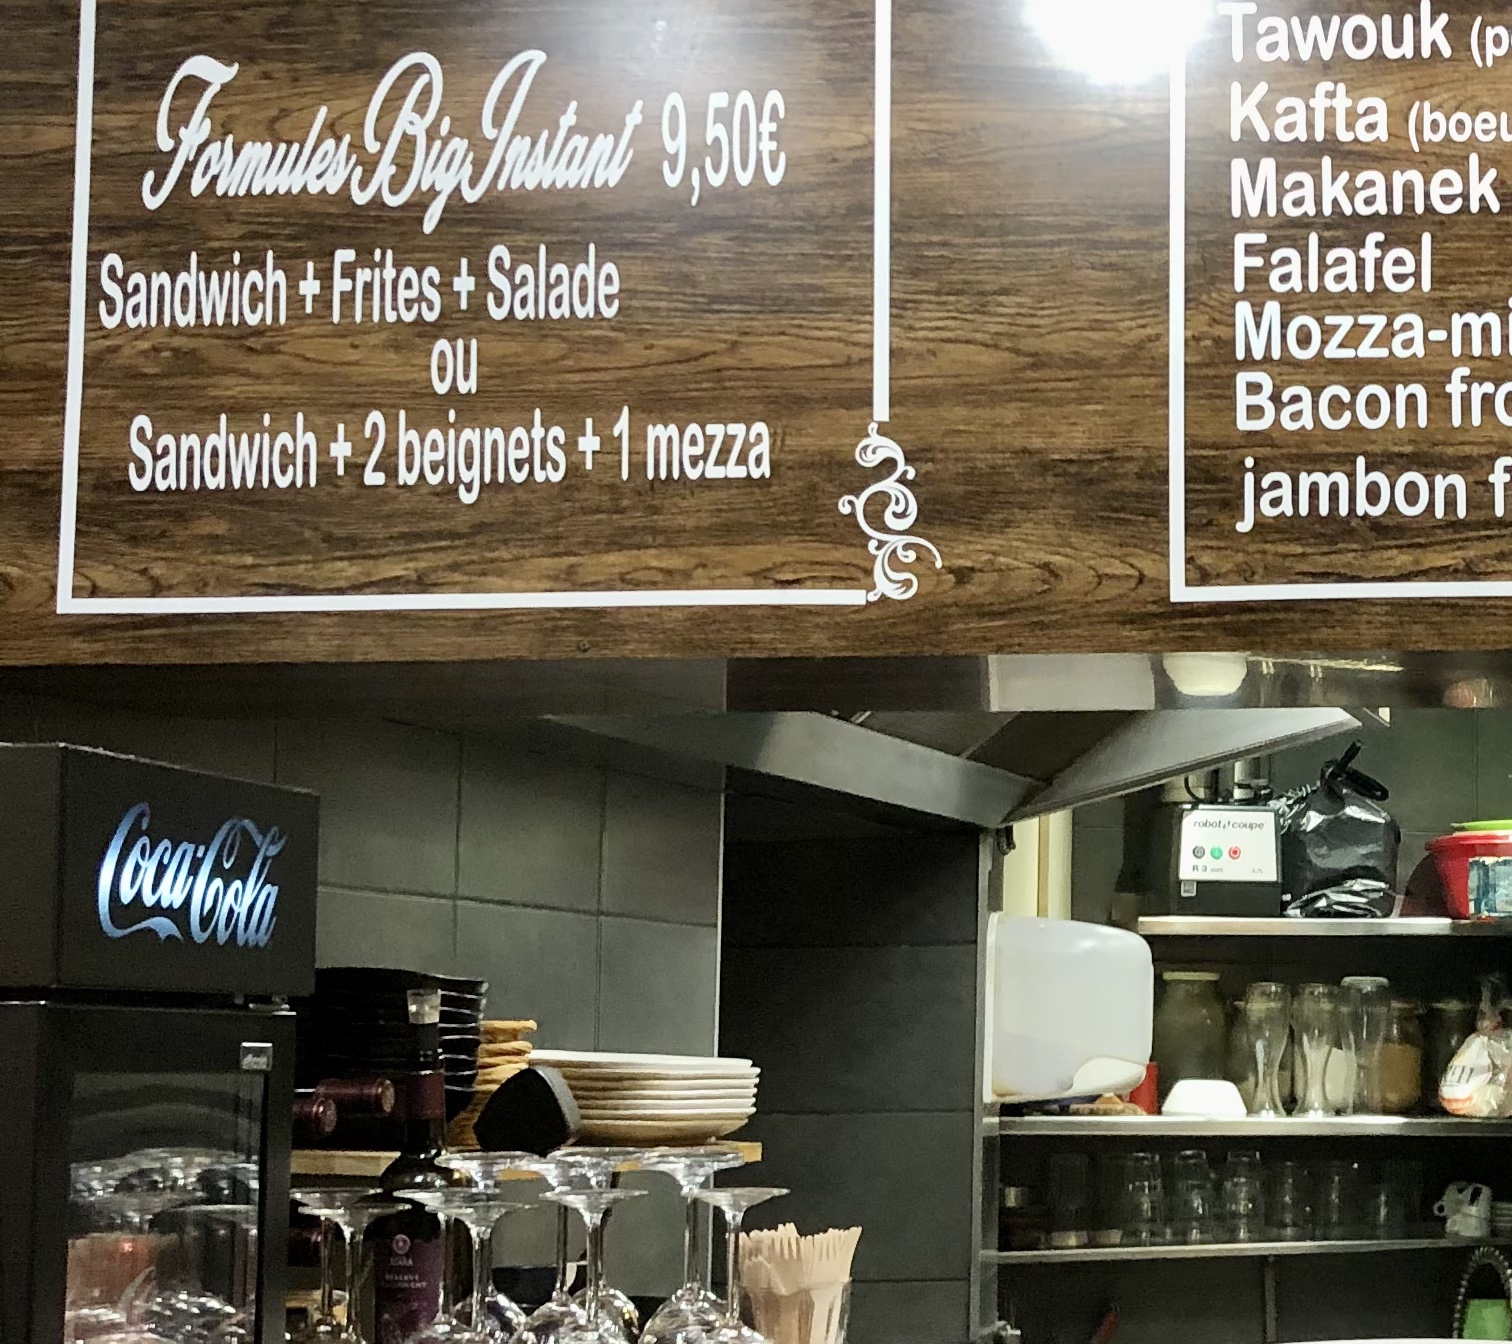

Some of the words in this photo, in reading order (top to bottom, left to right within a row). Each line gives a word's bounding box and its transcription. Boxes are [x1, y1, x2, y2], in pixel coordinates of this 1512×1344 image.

[141, 55, 355, 211] Formules
[350, 51, 472, 233] Big
[462, 49, 643, 203] Instant
[661, 90, 785, 205] 9,50€
[1228, 79, 1388, 141] Kafta
[1231, 153, 1500, 217] Makanek
[99, 250, 286, 329] Sandwich
[299, 261, 320, 313] +
[333, 248, 441, 324] Frites
[453, 258, 475, 309] +
[487, 243, 619, 320] Salade
[1234, 232, 1431, 292] Falafel
[431, 339, 477, 394] ou
[1236, 372, 1427, 430] Bacon
[129, 412, 316, 491] Sandwich
[330, 424, 351, 475] +
[364, 411, 385, 485] 2
[399, 408, 566, 504] beignets
[578, 418, 600, 469] +
[613, 406, 628, 480] 1
[647, 422, 770, 480] mezza
[1236, 456, 1466, 532] jambon
